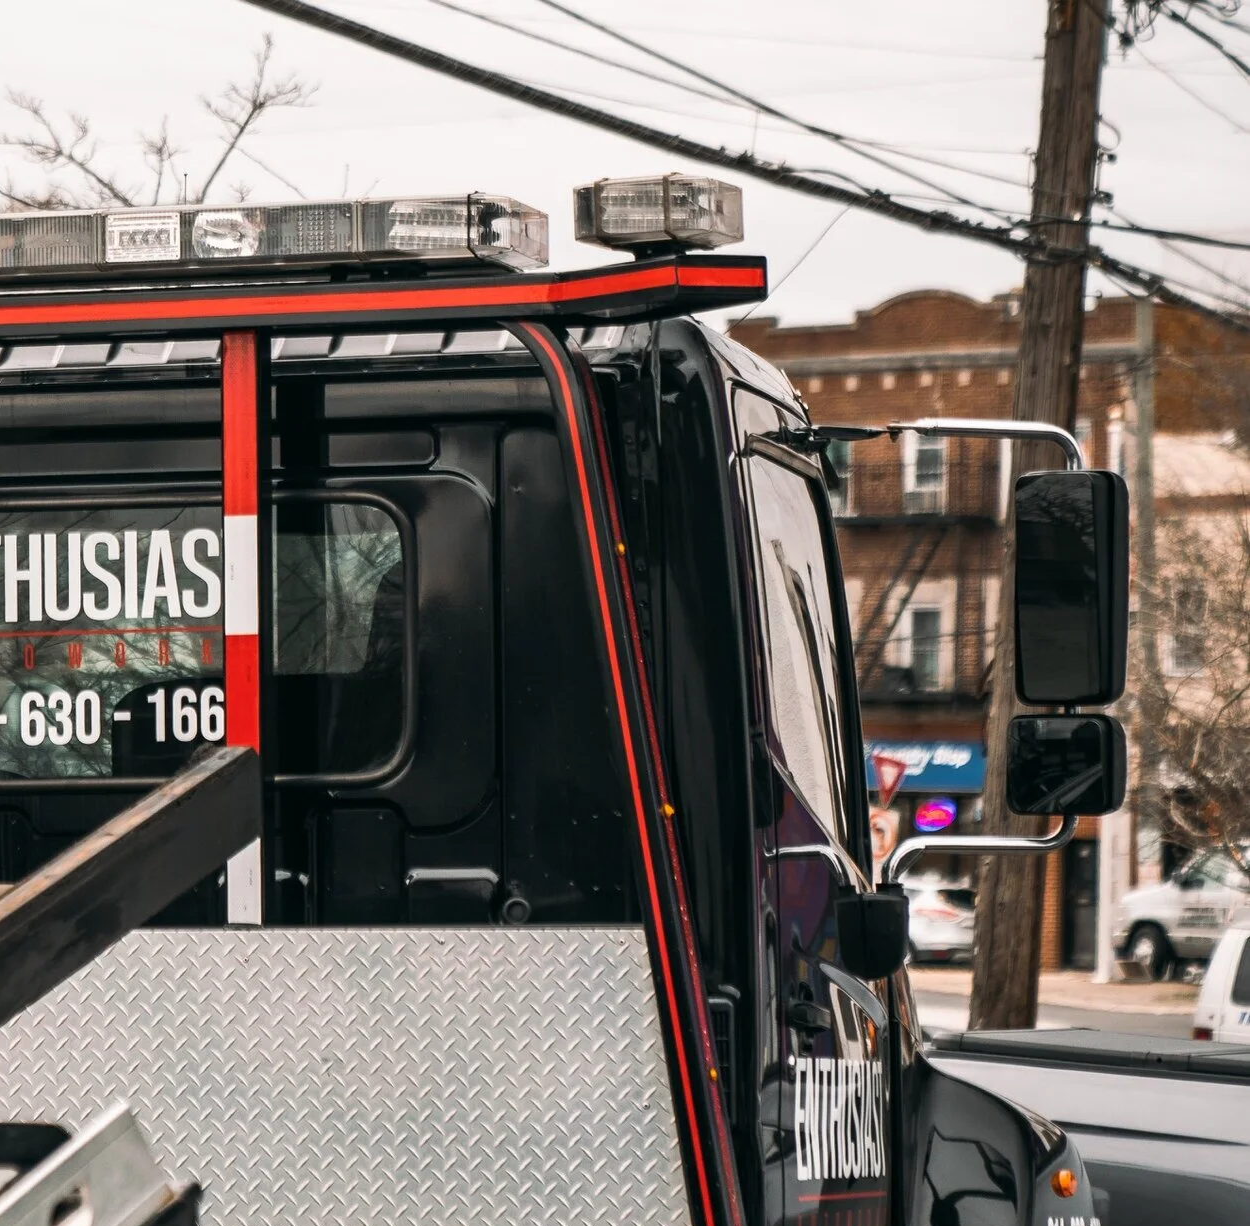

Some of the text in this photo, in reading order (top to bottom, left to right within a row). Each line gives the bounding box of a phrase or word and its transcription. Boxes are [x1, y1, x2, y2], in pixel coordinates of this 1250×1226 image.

[19, 689, 101, 748] 630
[147, 685, 225, 743] 166
[794, 1057, 886, 1182] ENTHUSIAST
